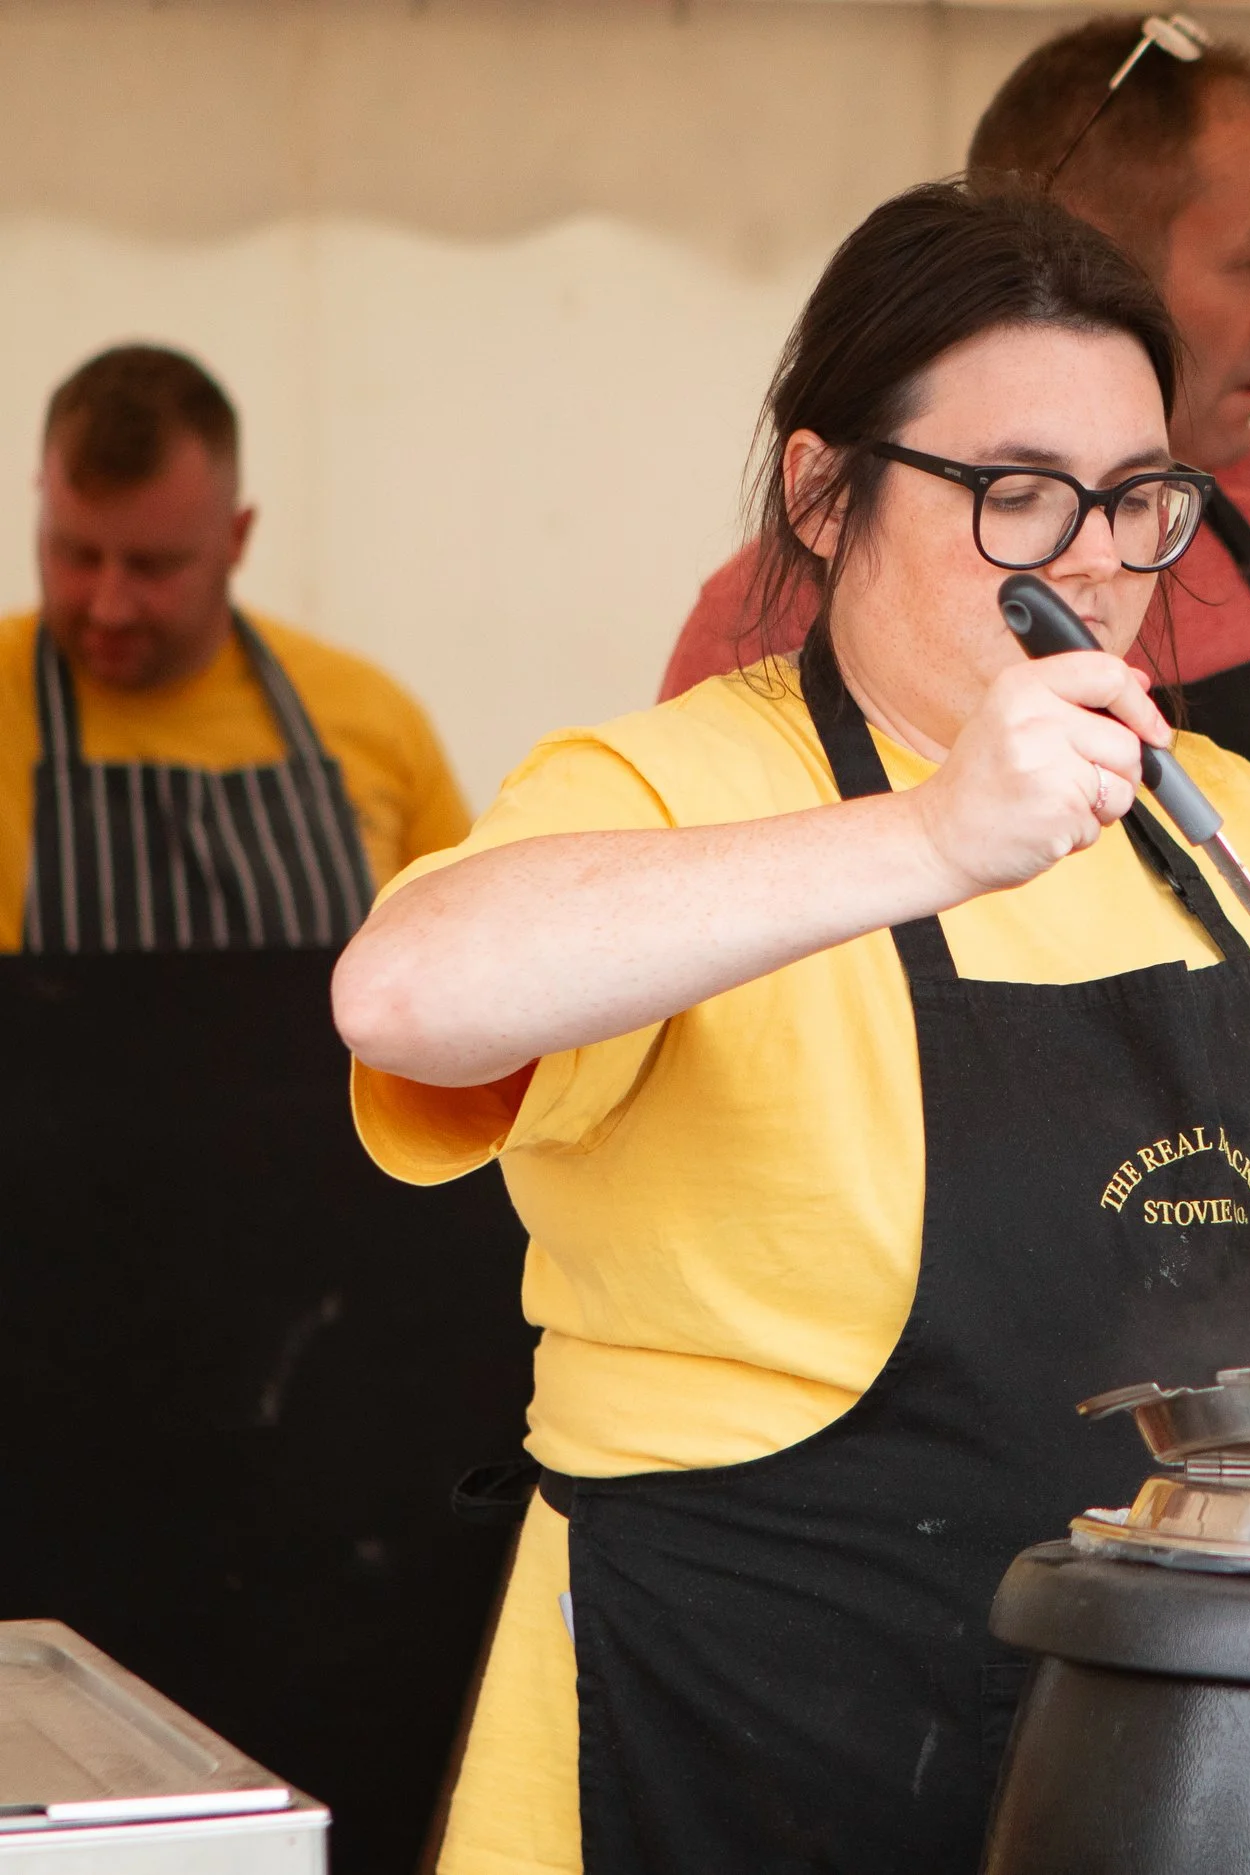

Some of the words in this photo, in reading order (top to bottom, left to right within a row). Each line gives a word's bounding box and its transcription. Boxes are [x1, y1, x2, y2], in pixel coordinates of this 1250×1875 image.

[1101, 1160, 1142, 1213] THE
[1137, 1127, 1213, 1172] REAL
[1143, 1199, 1232, 1226] STOVIE
